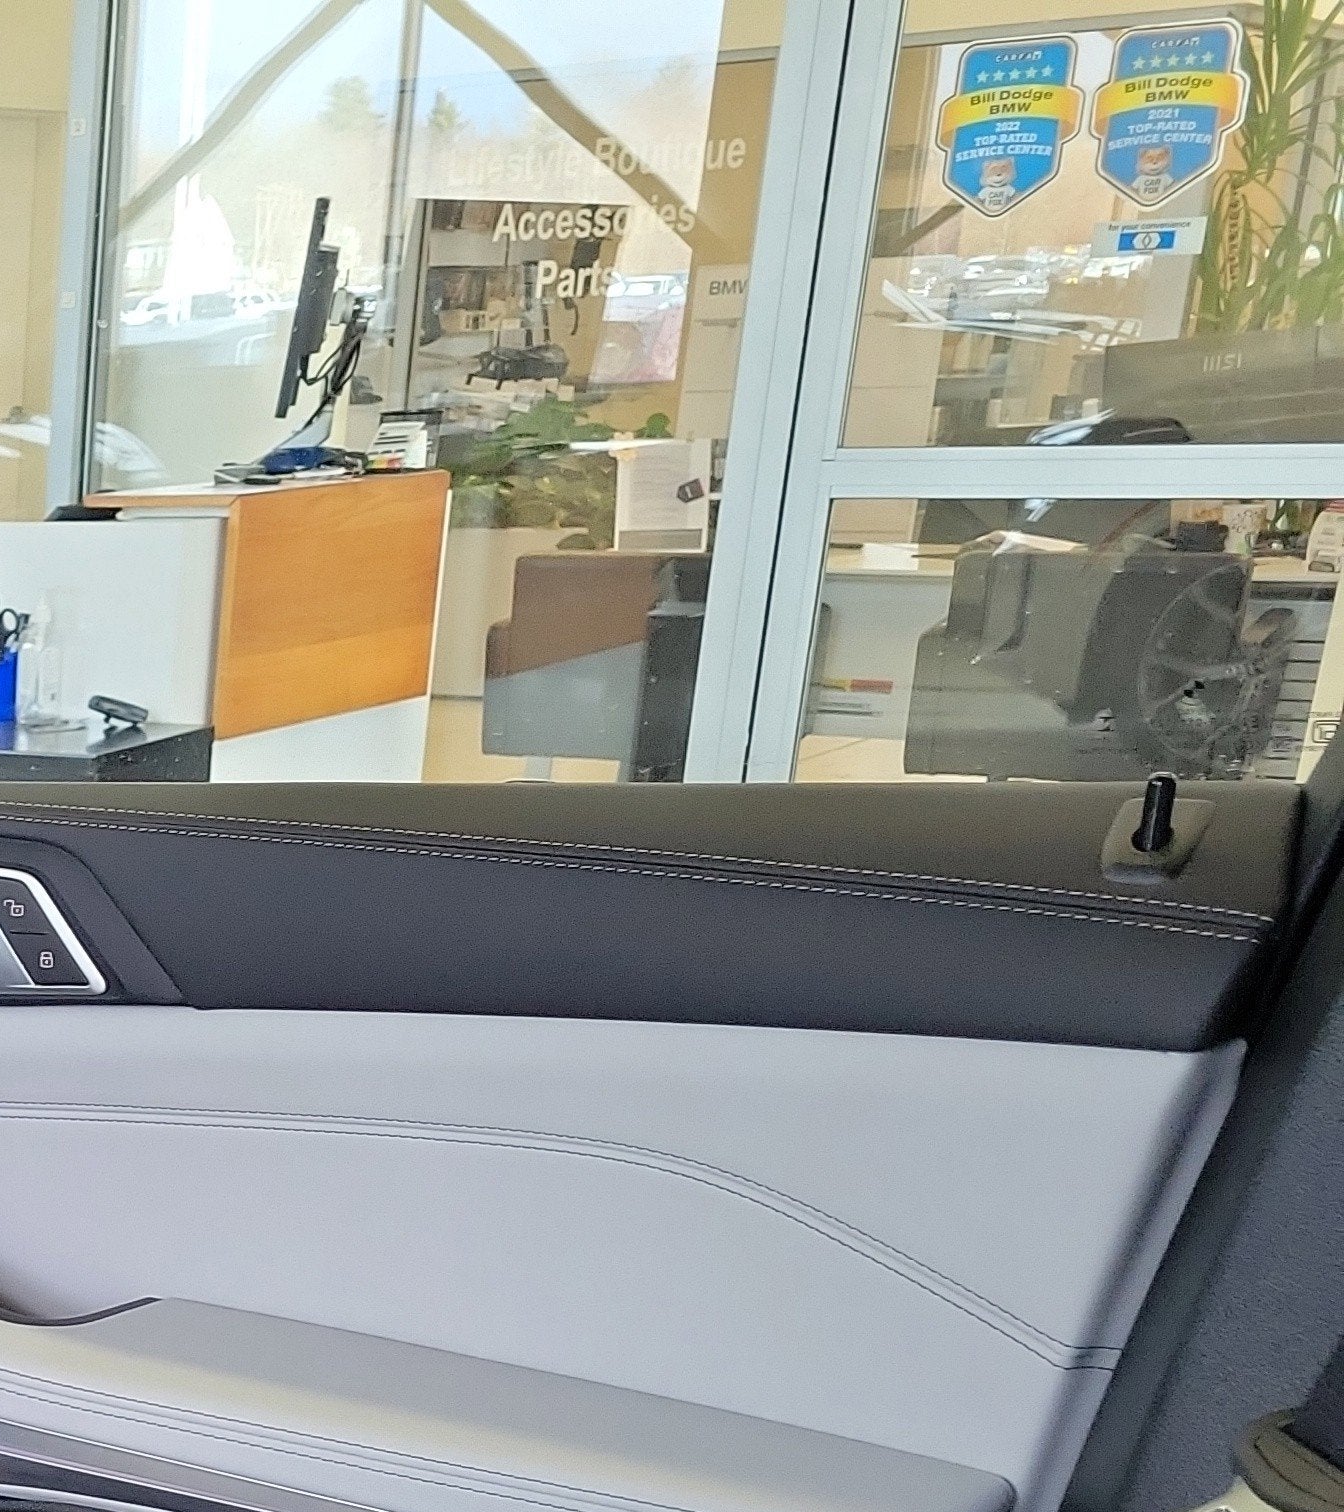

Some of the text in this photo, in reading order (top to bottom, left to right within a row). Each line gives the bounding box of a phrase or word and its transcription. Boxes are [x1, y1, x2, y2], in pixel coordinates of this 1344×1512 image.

[1125, 76, 1213, 93] Bill Dodge
[970, 89, 1053, 106] Bill Dodge
[1145, 89, 1190, 103] BMW
[989, 102, 1032, 115] BMW
[1147, 108, 1180, 120] 2021
[995, 121, 1021, 133] 2022
[1127, 121, 1197, 134] TOP-RATED
[974, 133, 1038, 147] TOP-RATED
[1108, 133, 1212, 151] SERVICE CENTER
[955, 144, 1052, 162] SERVICE CENTER
[492, 195, 696, 243] Accessoies
[534, 259, 619, 301] Parts
